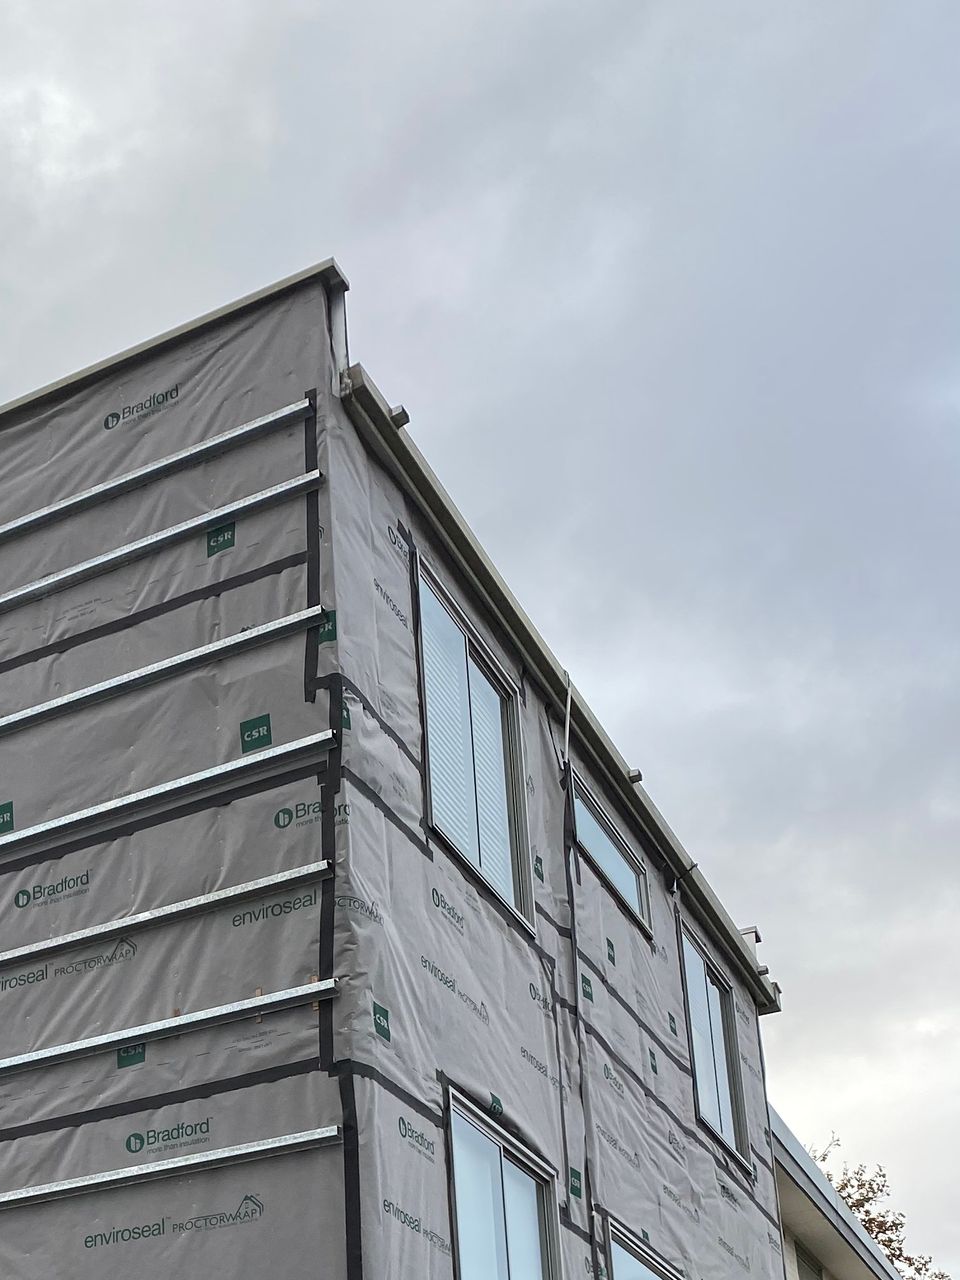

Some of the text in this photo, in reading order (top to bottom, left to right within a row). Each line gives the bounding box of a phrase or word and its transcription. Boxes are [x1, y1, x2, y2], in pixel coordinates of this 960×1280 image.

[122, 386, 179, 420] Bradford
[210, 530, 232, 546] CSR
[244, 726, 268, 742] CSR
[33, 872, 90, 901] Bradford
[233, 889, 317, 927] enviroseal
[54, 948, 132, 978] PROCTORWRAP
[146, 1121, 210, 1145] Bradford
[147, 1137, 210, 1154] more than insulation
[407, 1121, 434, 1155] Bradford
[84, 1208, 258, 1249] enviroseal PROCTORWRAP
[383, 1199, 421, 1233] enviroseal
